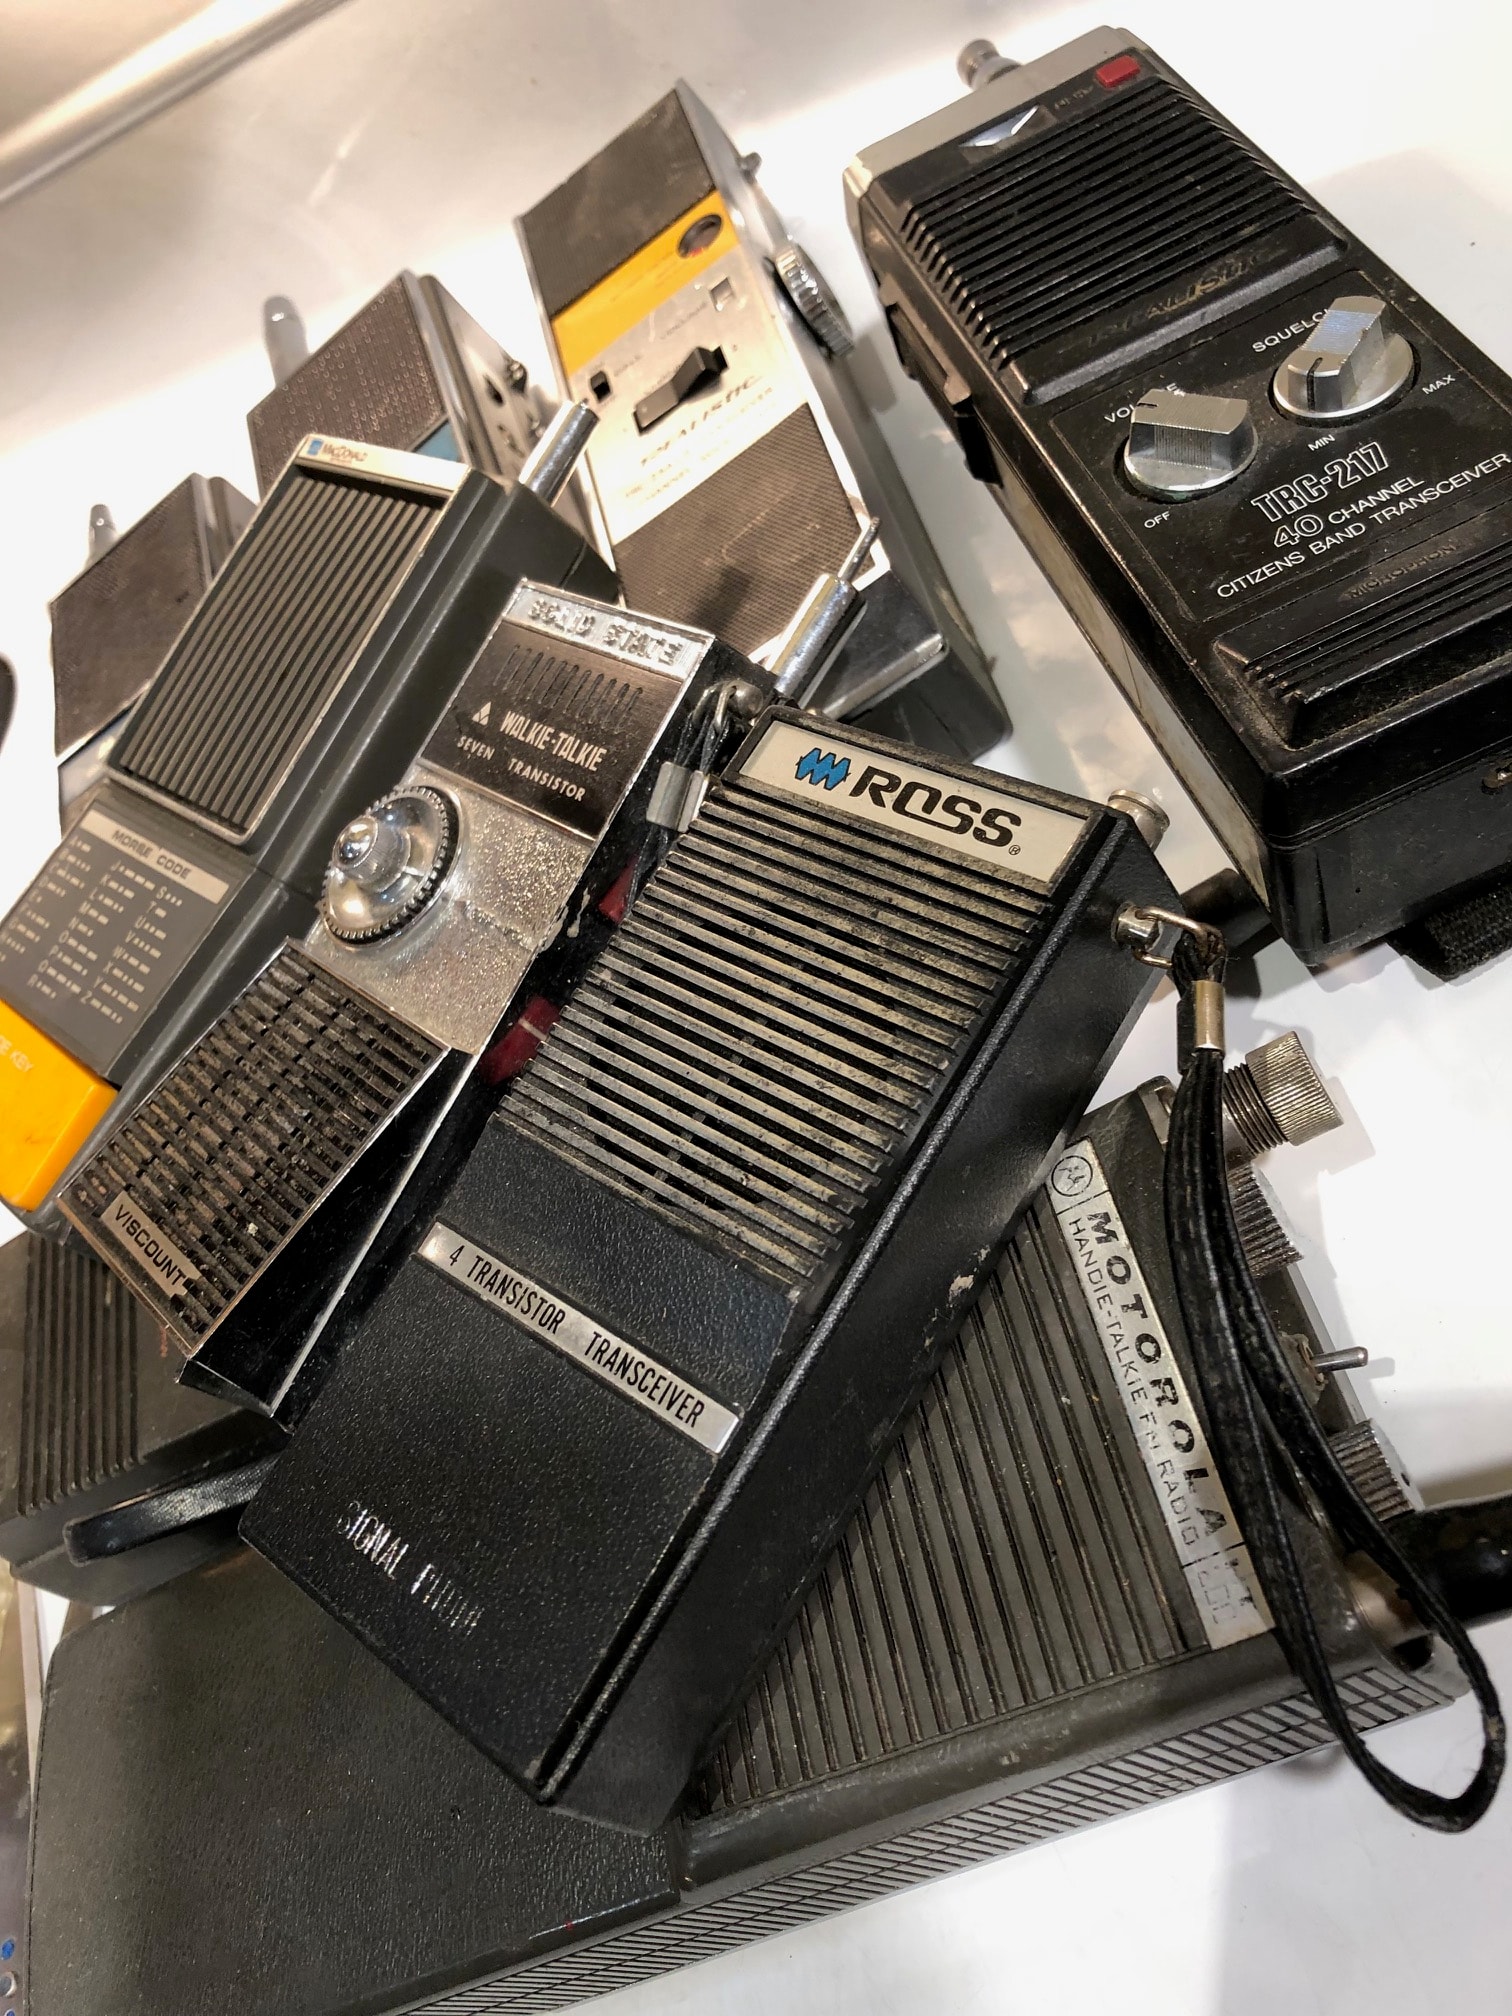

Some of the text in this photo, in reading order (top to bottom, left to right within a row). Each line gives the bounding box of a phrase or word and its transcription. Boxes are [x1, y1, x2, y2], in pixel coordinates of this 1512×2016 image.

[1422, 374, 1456, 395] MAX
[1307, 434, 1336, 452] MIN
[1251, 442, 1389, 522] TRC-217
[1273, 476, 1424, 548] 40 CHANNEL
[1143, 511, 1171, 530] OFF
[1217, 453, 1512, 599] CITIZENS BAND TRANSCEIVER
[528, 598, 683, 666] SOLID STATE
[457, 736, 587, 802] SEVEN TRANSISTOR
[500, 710, 608, 772] WALKIE-TALKIE
[849, 765, 1022, 848] ROSS
[112, 829, 192, 880] MORSE CODE
[115, 1204, 187, 1286] VISCOUNT
[449, 1244, 706, 1429] 4 TRANSISTOR TRANSCEIVER
[1086, 1210, 1228, 1538] MOTOROLA
[1068, 1217, 1150, 1404] HANDIE-TALKIE
[1156, 1458, 1200, 1547] RADIO
[336, 1500, 409, 1580] SIGNAL
